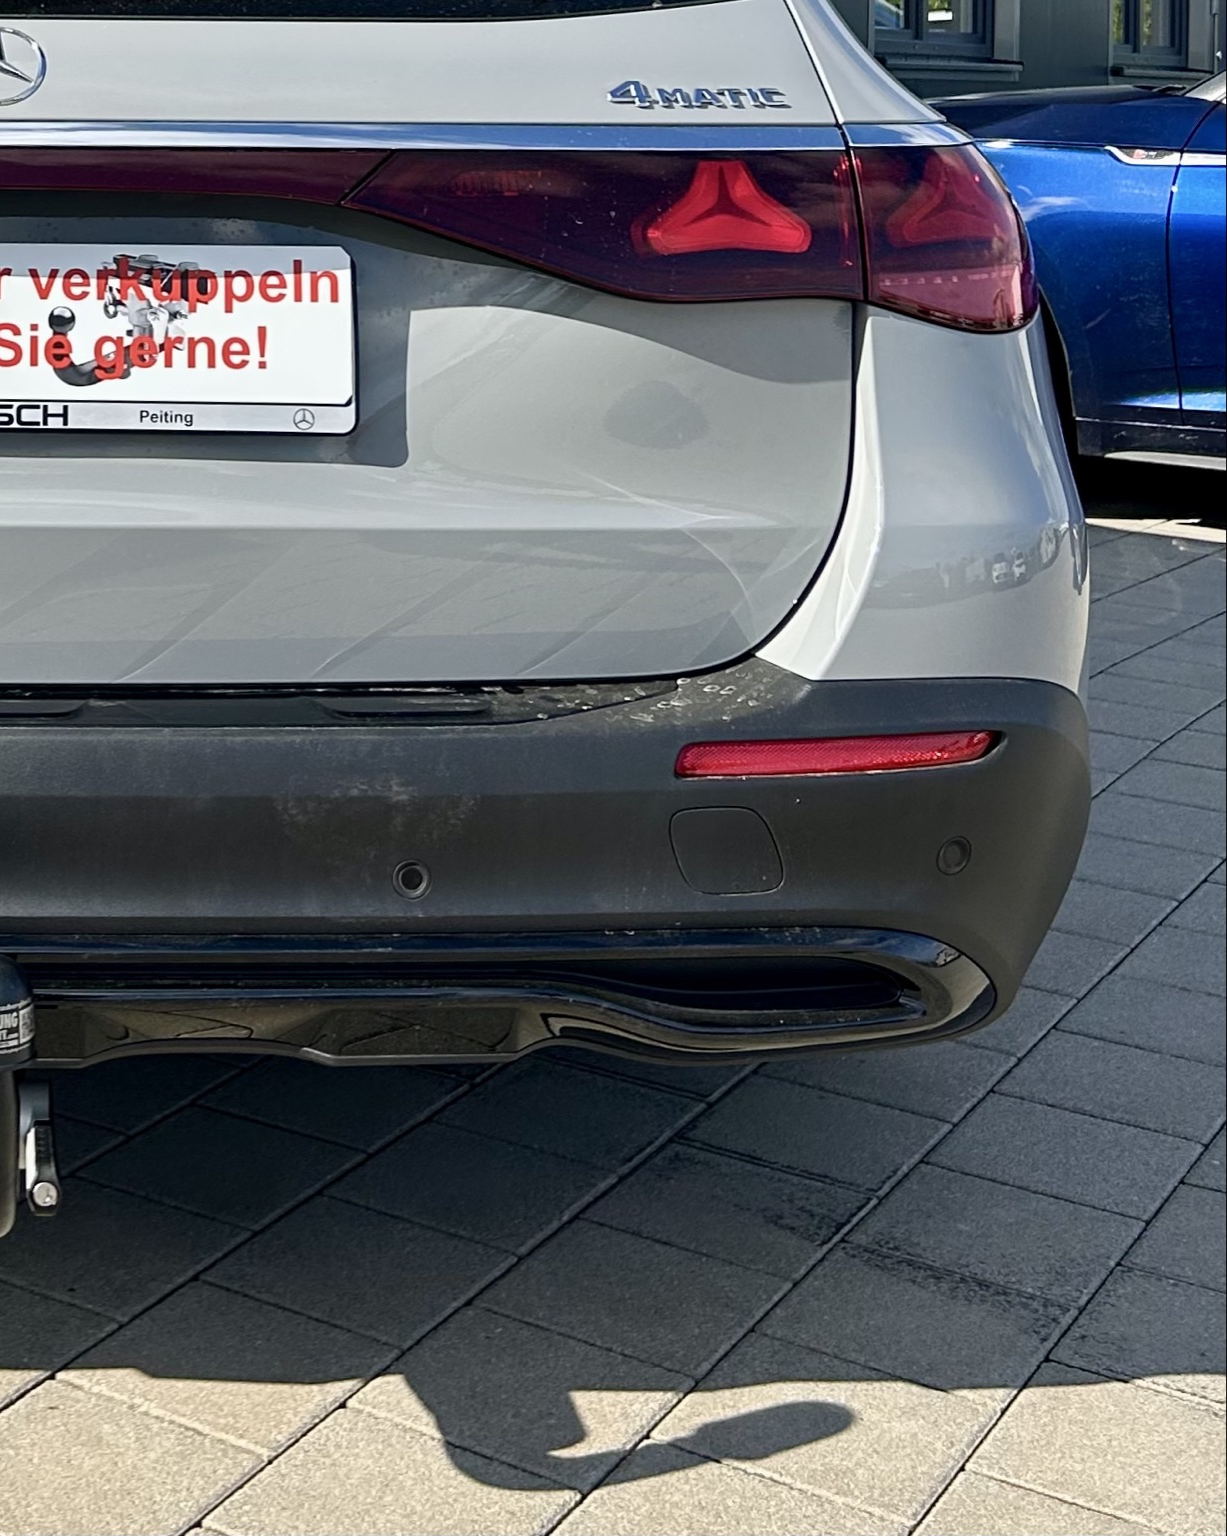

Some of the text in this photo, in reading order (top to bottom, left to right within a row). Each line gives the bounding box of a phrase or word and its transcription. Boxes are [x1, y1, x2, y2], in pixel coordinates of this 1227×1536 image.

[606, 80, 792, 110] 4MATIC
[28, 257, 340, 313] verkuppeln
[94, 326, 268, 380] gerne!
[139, 410, 194, 427] Peiting
